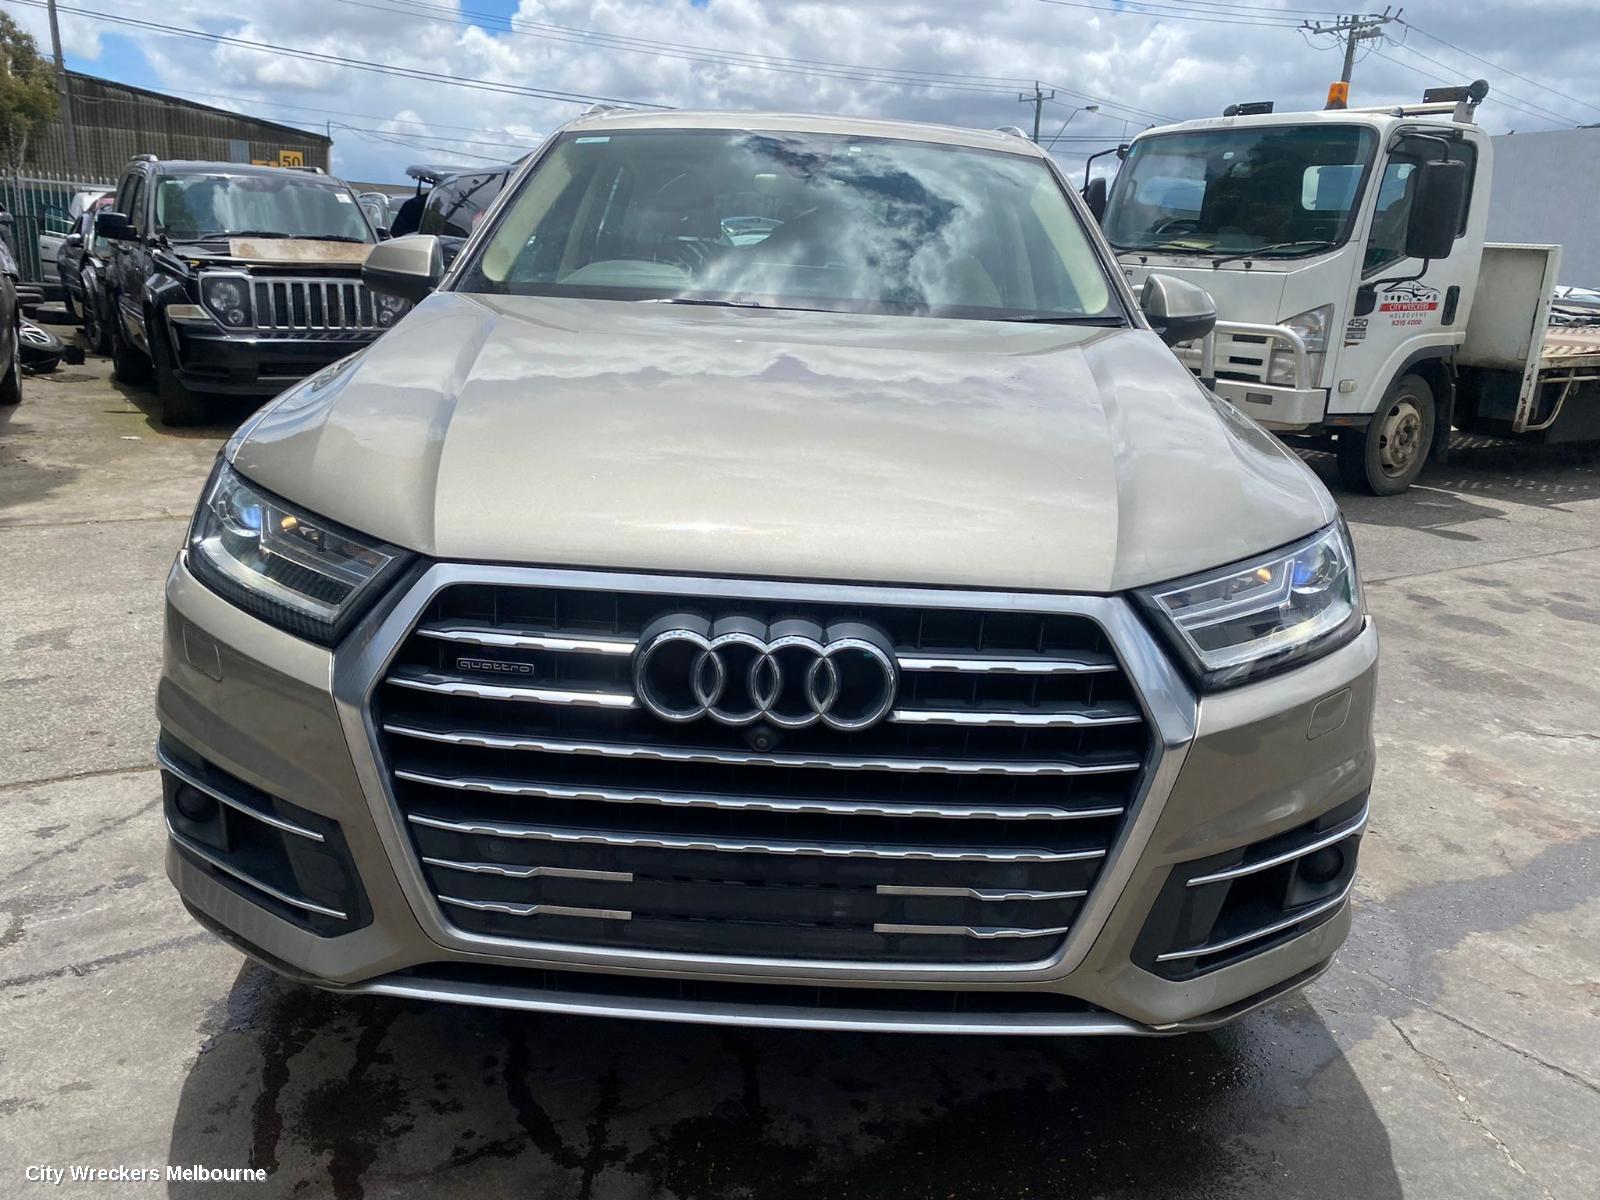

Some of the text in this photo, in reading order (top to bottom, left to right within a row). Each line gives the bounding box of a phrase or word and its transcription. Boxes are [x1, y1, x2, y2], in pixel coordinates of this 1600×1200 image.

[283, 156, 300, 167] 50
[1389, 303, 1402, 311] CITY
[1348, 319, 1369, 327] 450
[460, 660, 530, 673] quattro
